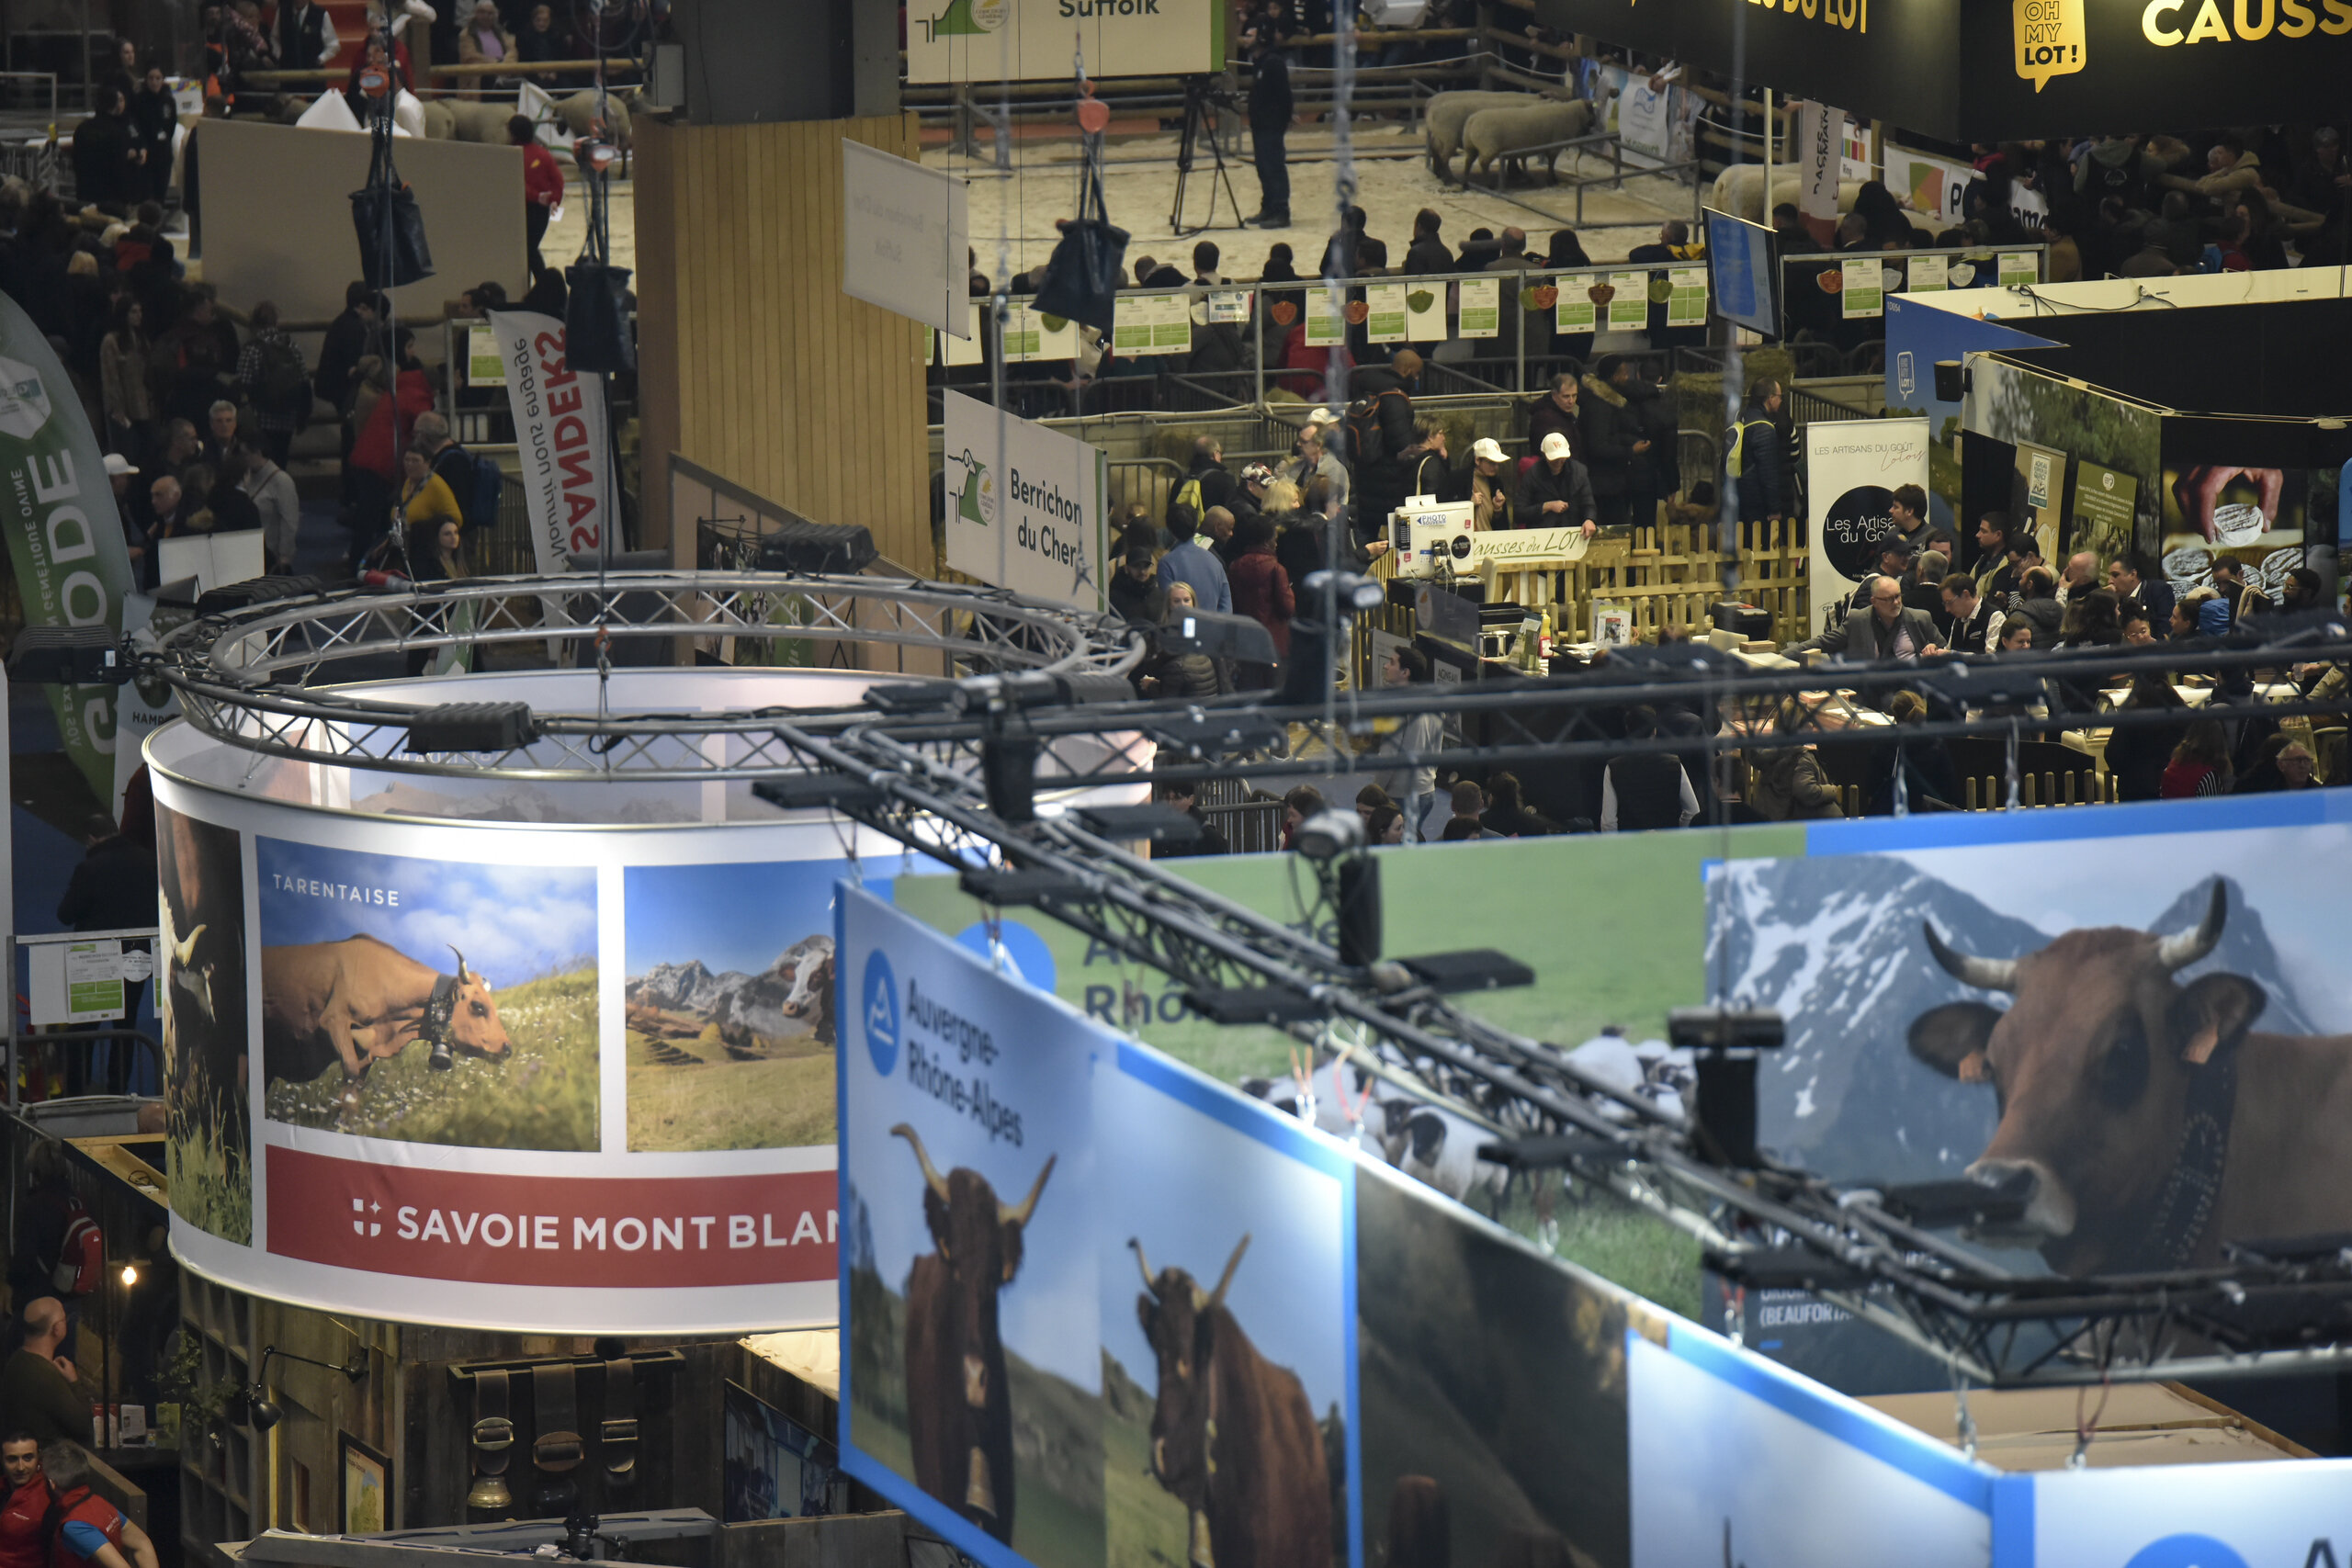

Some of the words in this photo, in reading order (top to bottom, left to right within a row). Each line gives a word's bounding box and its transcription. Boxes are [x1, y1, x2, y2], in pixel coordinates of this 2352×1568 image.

[1058, 0, 1159, 17] Suffolk
[1825, 0, 1866, 33] LOT
[2024, 1, 2060, 21] OH
[2024, 23, 2063, 44] MY
[2142, 0, 2352, 46] CAUSS
[2024, 46, 2066, 66] LOT
[1815, 446, 1829, 456] LES
[1832, 444, 1872, 454] ARTISANS
[1875, 443, 1888, 453] DU
[1011, 467, 1082, 526] Berrichon
[1826, 516, 1851, 531] Les
[1857, 514, 1896, 529] Artisa
[1017, 515, 1036, 551] du
[1041, 524, 1077, 567] Cher
[1473, 536, 1522, 556] ausses
[1526, 536, 1540, 551] du
[1544, 531, 1583, 551] LOT
[1840, 529, 1859, 544] du
[1865, 528, 1883, 543] Go
[273, 874, 400, 907] TARENTAISE
[908, 976, 1000, 1066] Auvergne-
[908, 1039, 1023, 1148] Rhône-Alpes
[397, 1205, 560, 1251] SAVOIE
[573, 1215, 716, 1253] MONT
[729, 1209, 839, 1248] BLAN
[1759, 1303, 1852, 1328] (BEAUFOR
